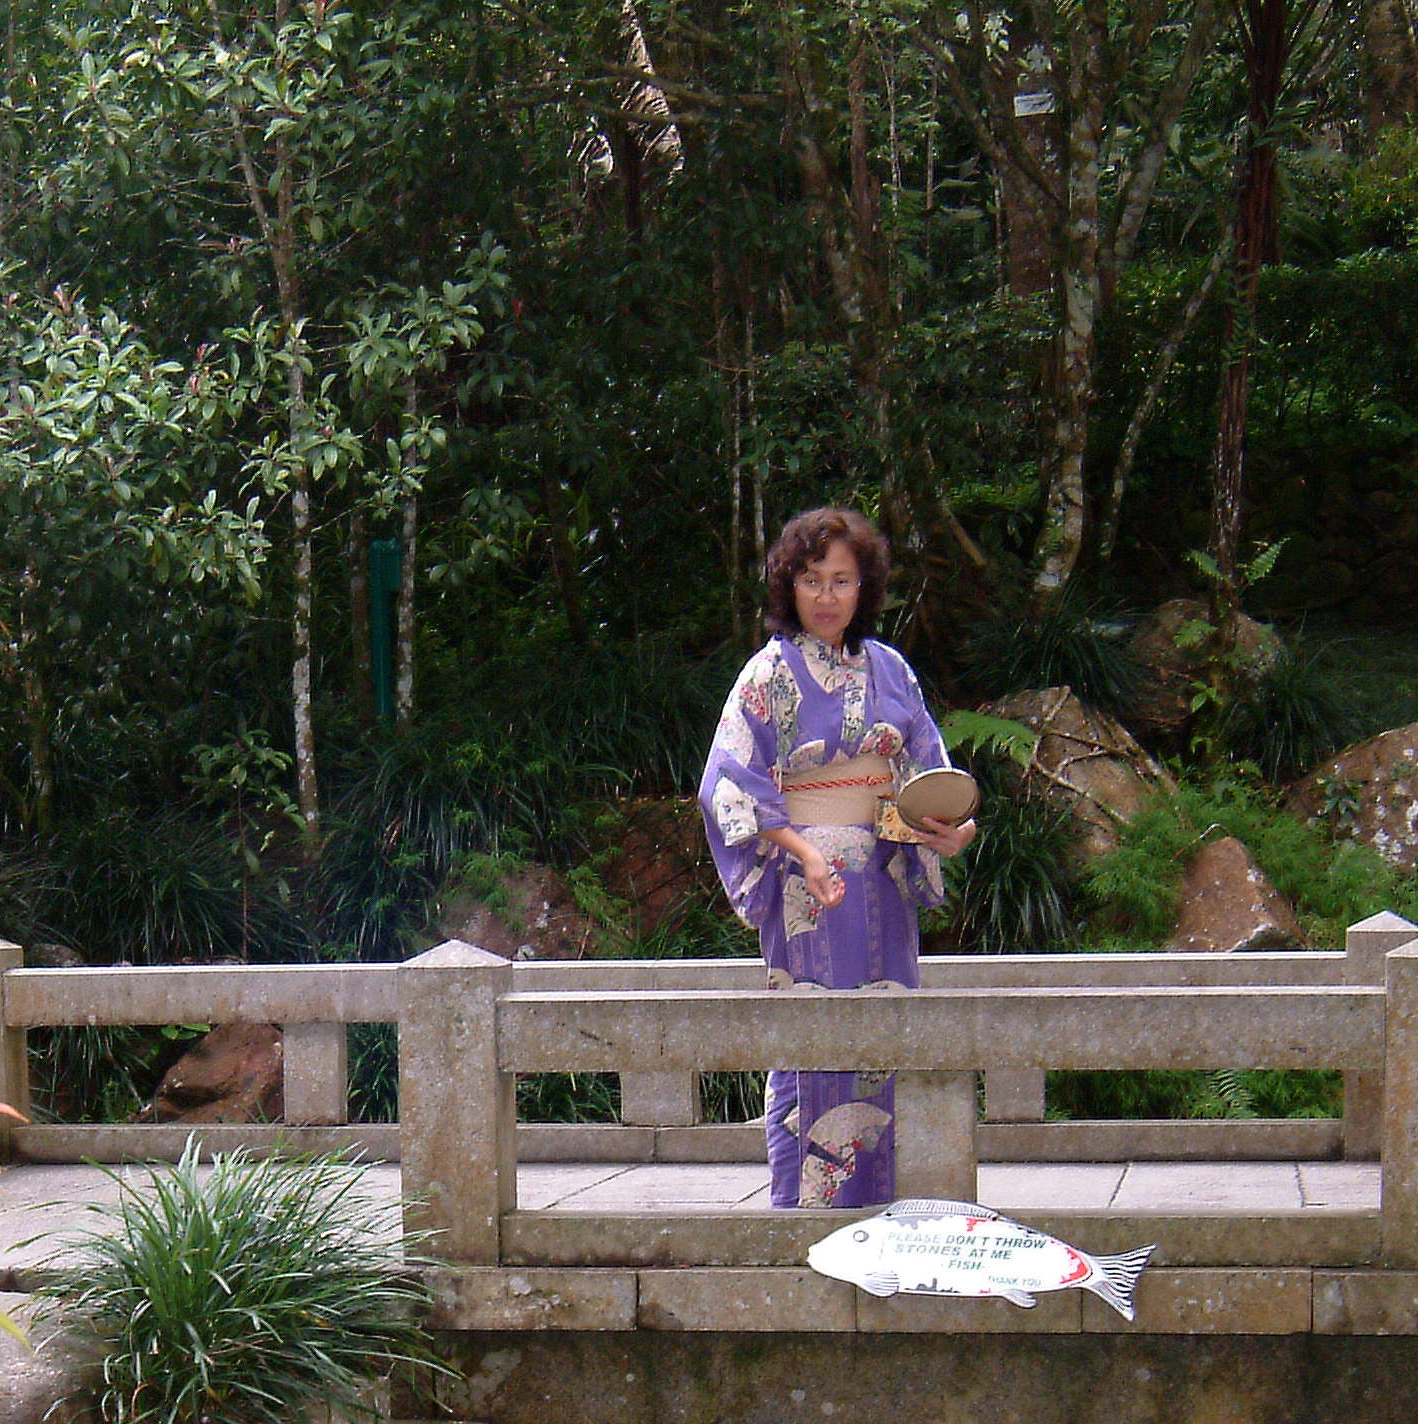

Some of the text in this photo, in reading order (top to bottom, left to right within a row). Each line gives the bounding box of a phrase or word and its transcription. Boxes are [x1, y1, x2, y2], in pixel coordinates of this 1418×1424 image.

[887, 1232, 941, 1243] PLEASE
[994, 1236, 1047, 1249] THROW
[895, 1244, 1012, 1260] STONES AT ME
